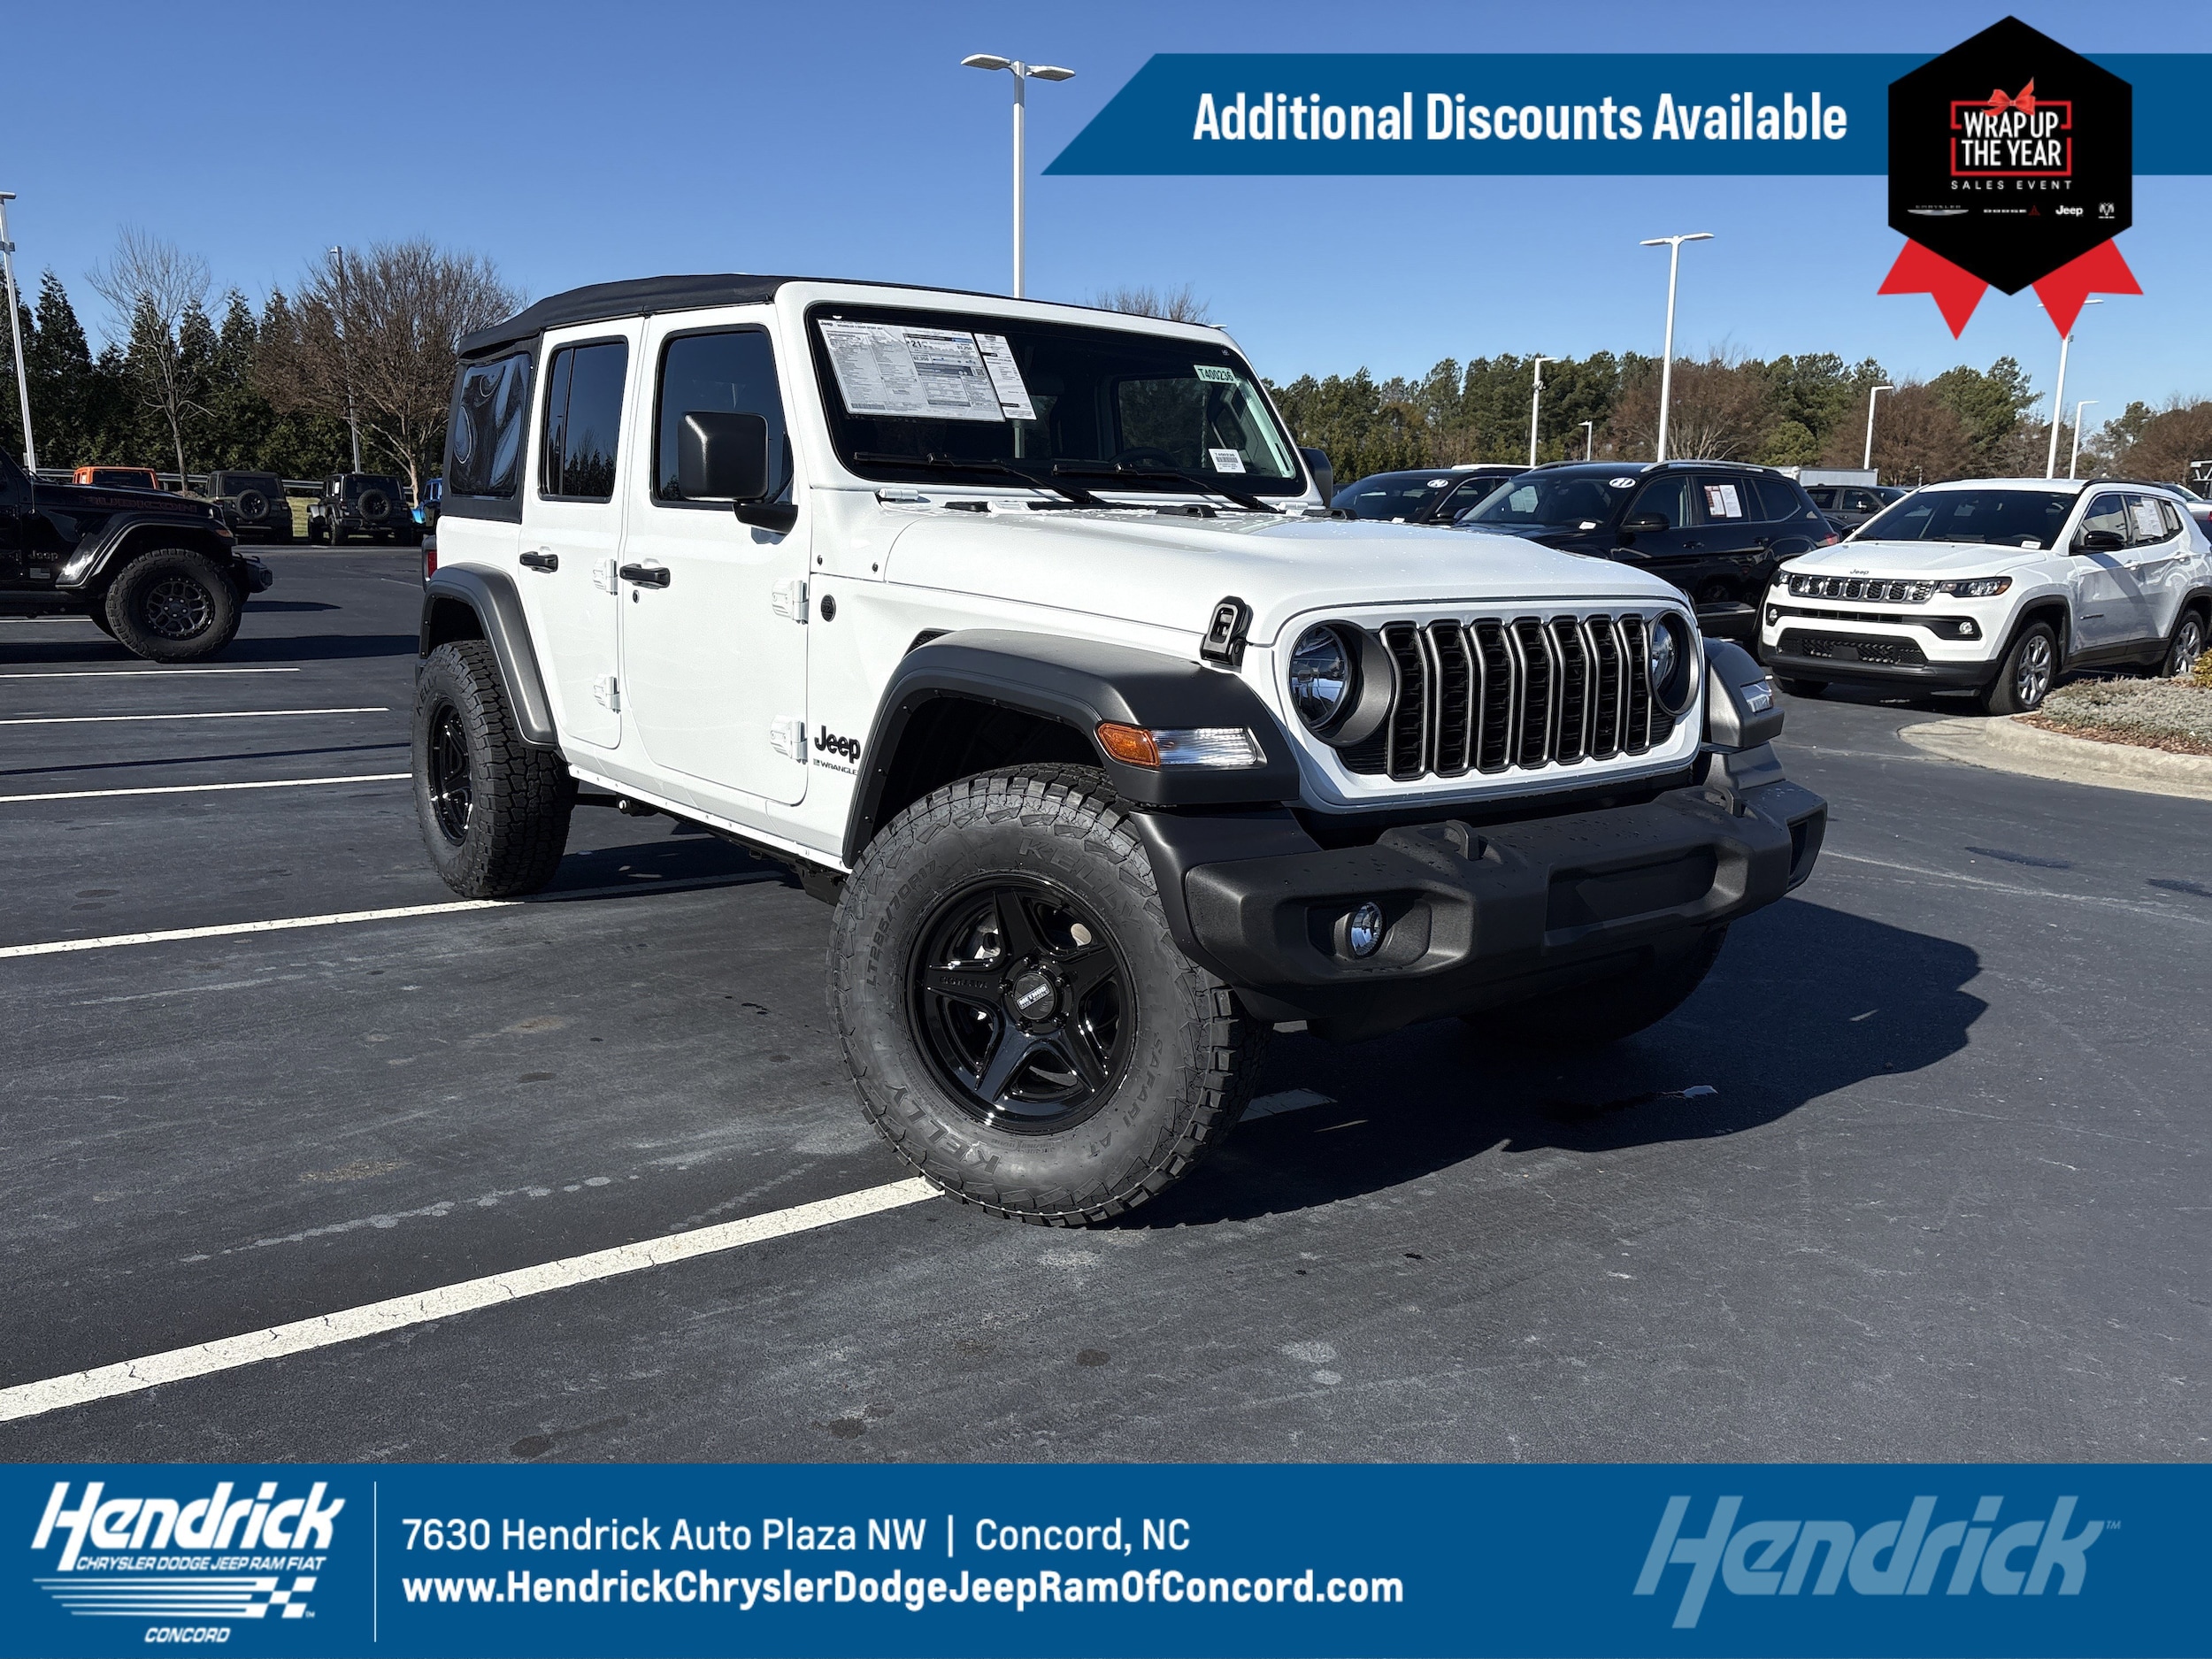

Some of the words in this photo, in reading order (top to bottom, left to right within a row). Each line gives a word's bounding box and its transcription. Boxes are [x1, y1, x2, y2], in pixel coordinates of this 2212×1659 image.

[1197, 368, 1234, 382] T400236
[28, 549, 58, 562] Jeep
[1849, 567, 1870, 576] Jeep
[814, 725, 861, 764] Jeep
[821, 760, 858, 776] WRANGLE
[1018, 836, 1145, 932] KELLY
[865, 859, 937, 988] LT285/70R17
[1018, 984, 1048, 1006] METHOD
[1122, 1033, 1164, 1128] SAFARI
[885, 1080, 1002, 1175] KELLY
